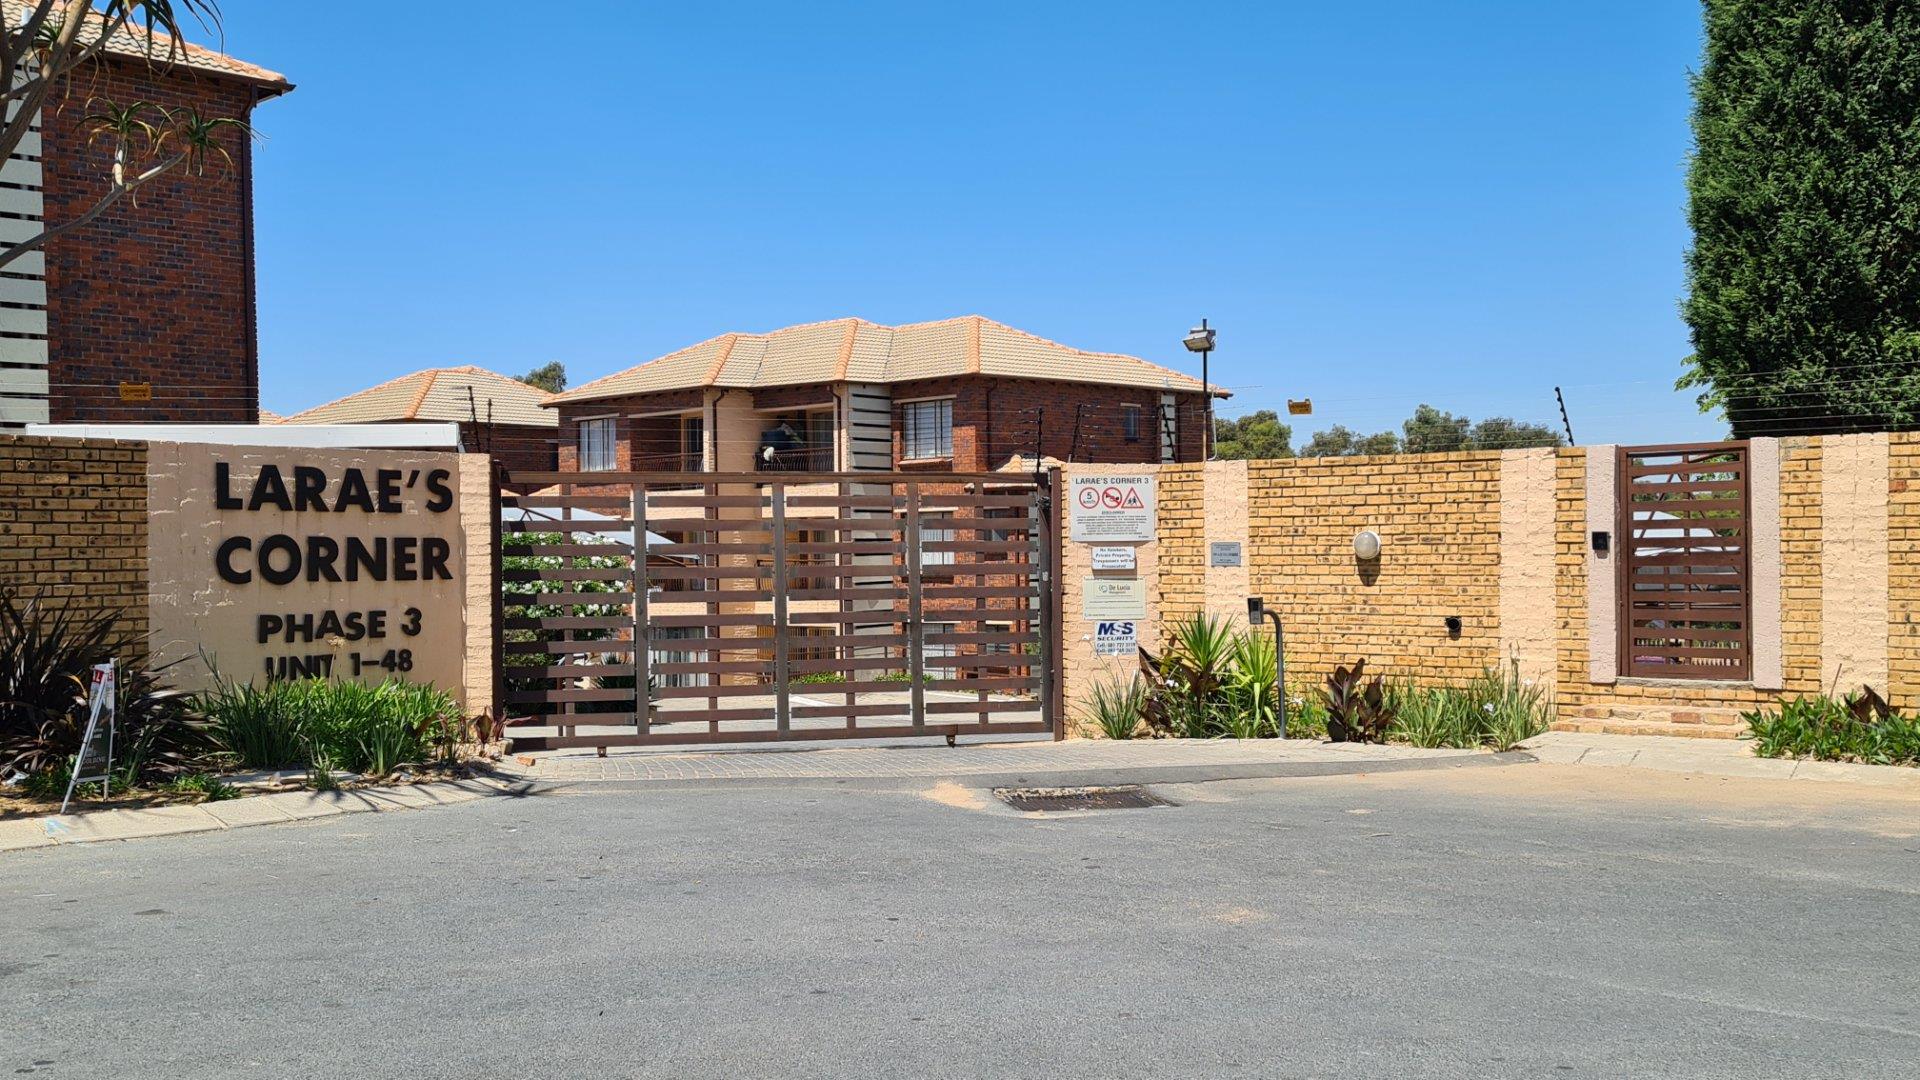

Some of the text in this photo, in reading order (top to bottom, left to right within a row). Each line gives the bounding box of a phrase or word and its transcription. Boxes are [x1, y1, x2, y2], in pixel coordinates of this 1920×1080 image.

[216, 462, 453, 513] LARAE'S
[1075, 477, 1108, 485] LARAE'S
[1086, 492, 1092, 500] 5
[216, 534, 453, 585] CORNER
[257, 607, 422, 643] PHASE 3
[265, 653, 335, 682] UNIT
